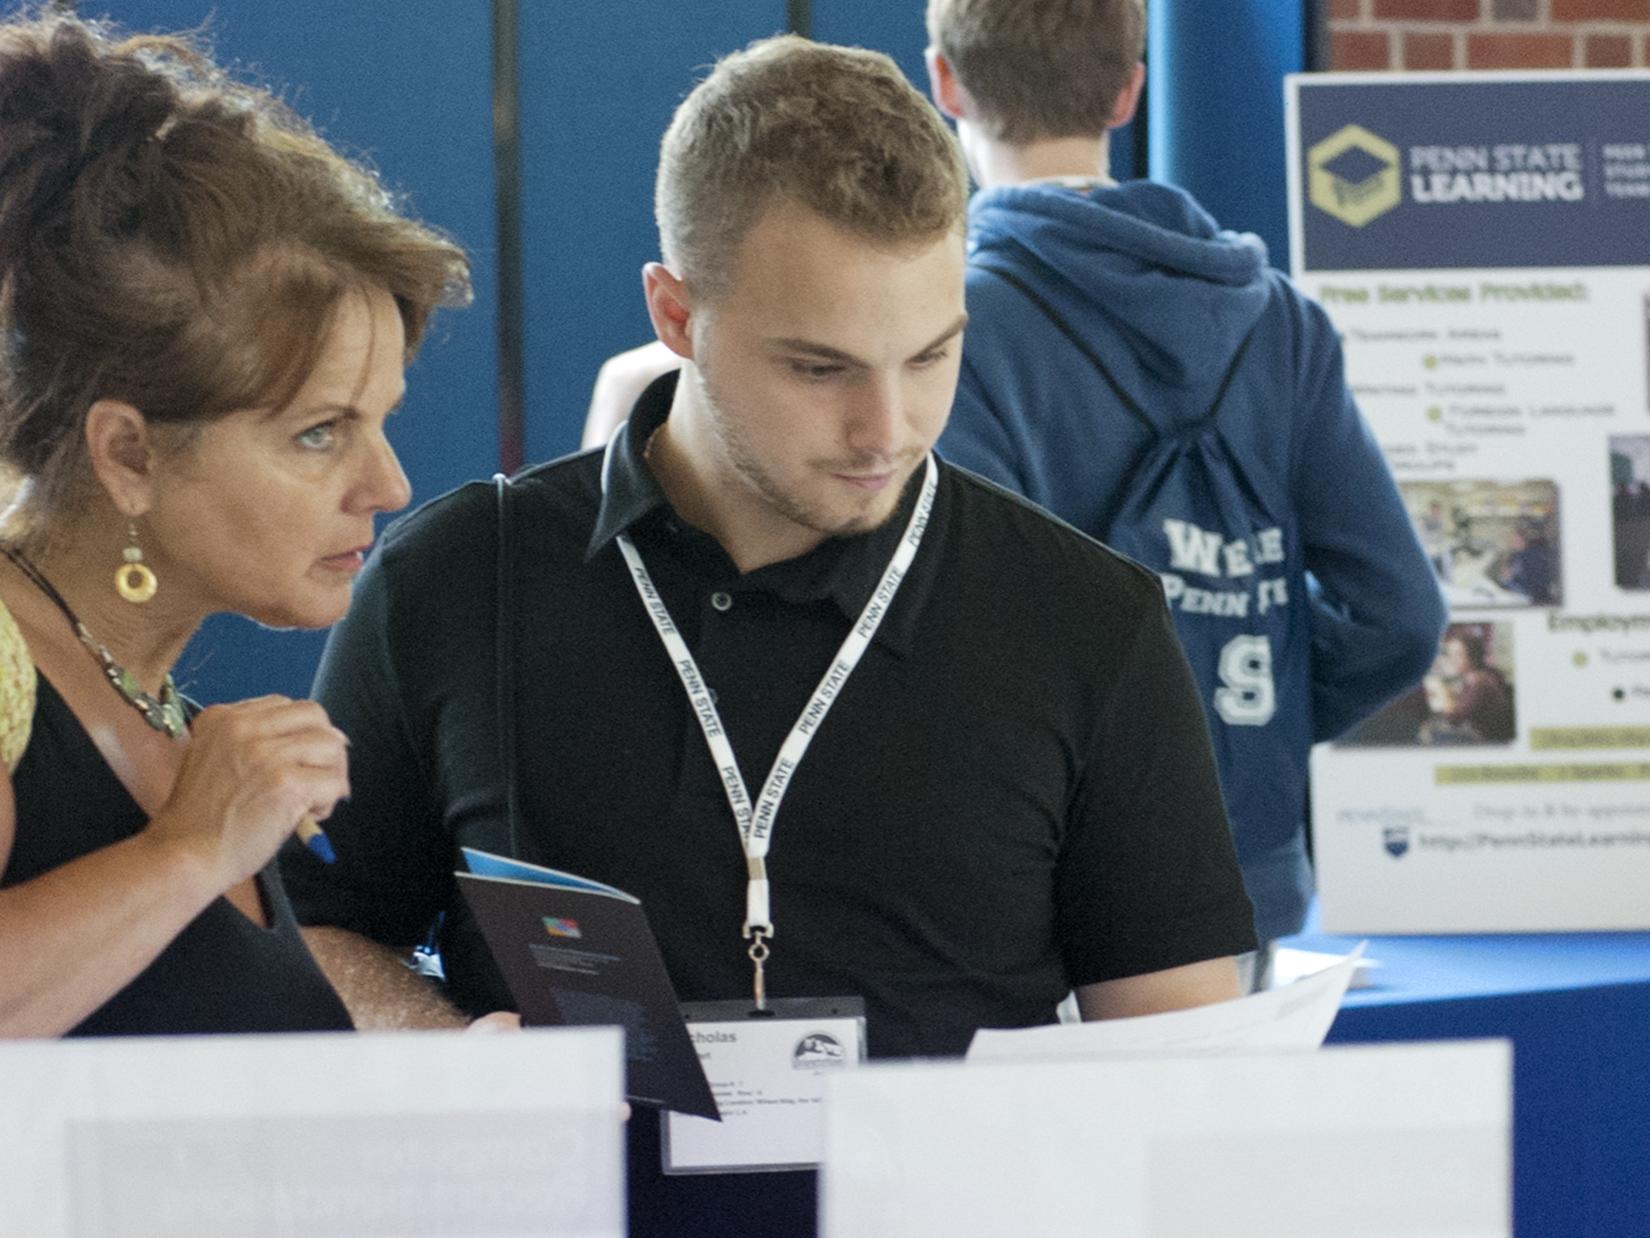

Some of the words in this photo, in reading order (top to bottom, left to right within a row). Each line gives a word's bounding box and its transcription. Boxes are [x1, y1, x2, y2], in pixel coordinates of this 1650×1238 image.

[1409, 145, 1488, 171] PENN
[1492, 143, 1583, 170] STATE
[1410, 172, 1585, 203] LEARNING
[634, 567, 657, 599] PENN
[651, 601, 677, 635] STATE
[857, 604, 882, 638] PENN
[877, 567, 902, 602] STATE
[679, 659, 702, 695] PENN
[695, 697, 722, 738] STATE
[798, 698, 827, 735] PENN
[821, 659, 850, 699] STATE
[1214, 634, 1276, 726] S
[722, 766, 745, 804] PENN
[753, 800, 775, 839] PENN
[766, 757, 795, 799] STATE
[690, 1031, 737, 1043] cholas
